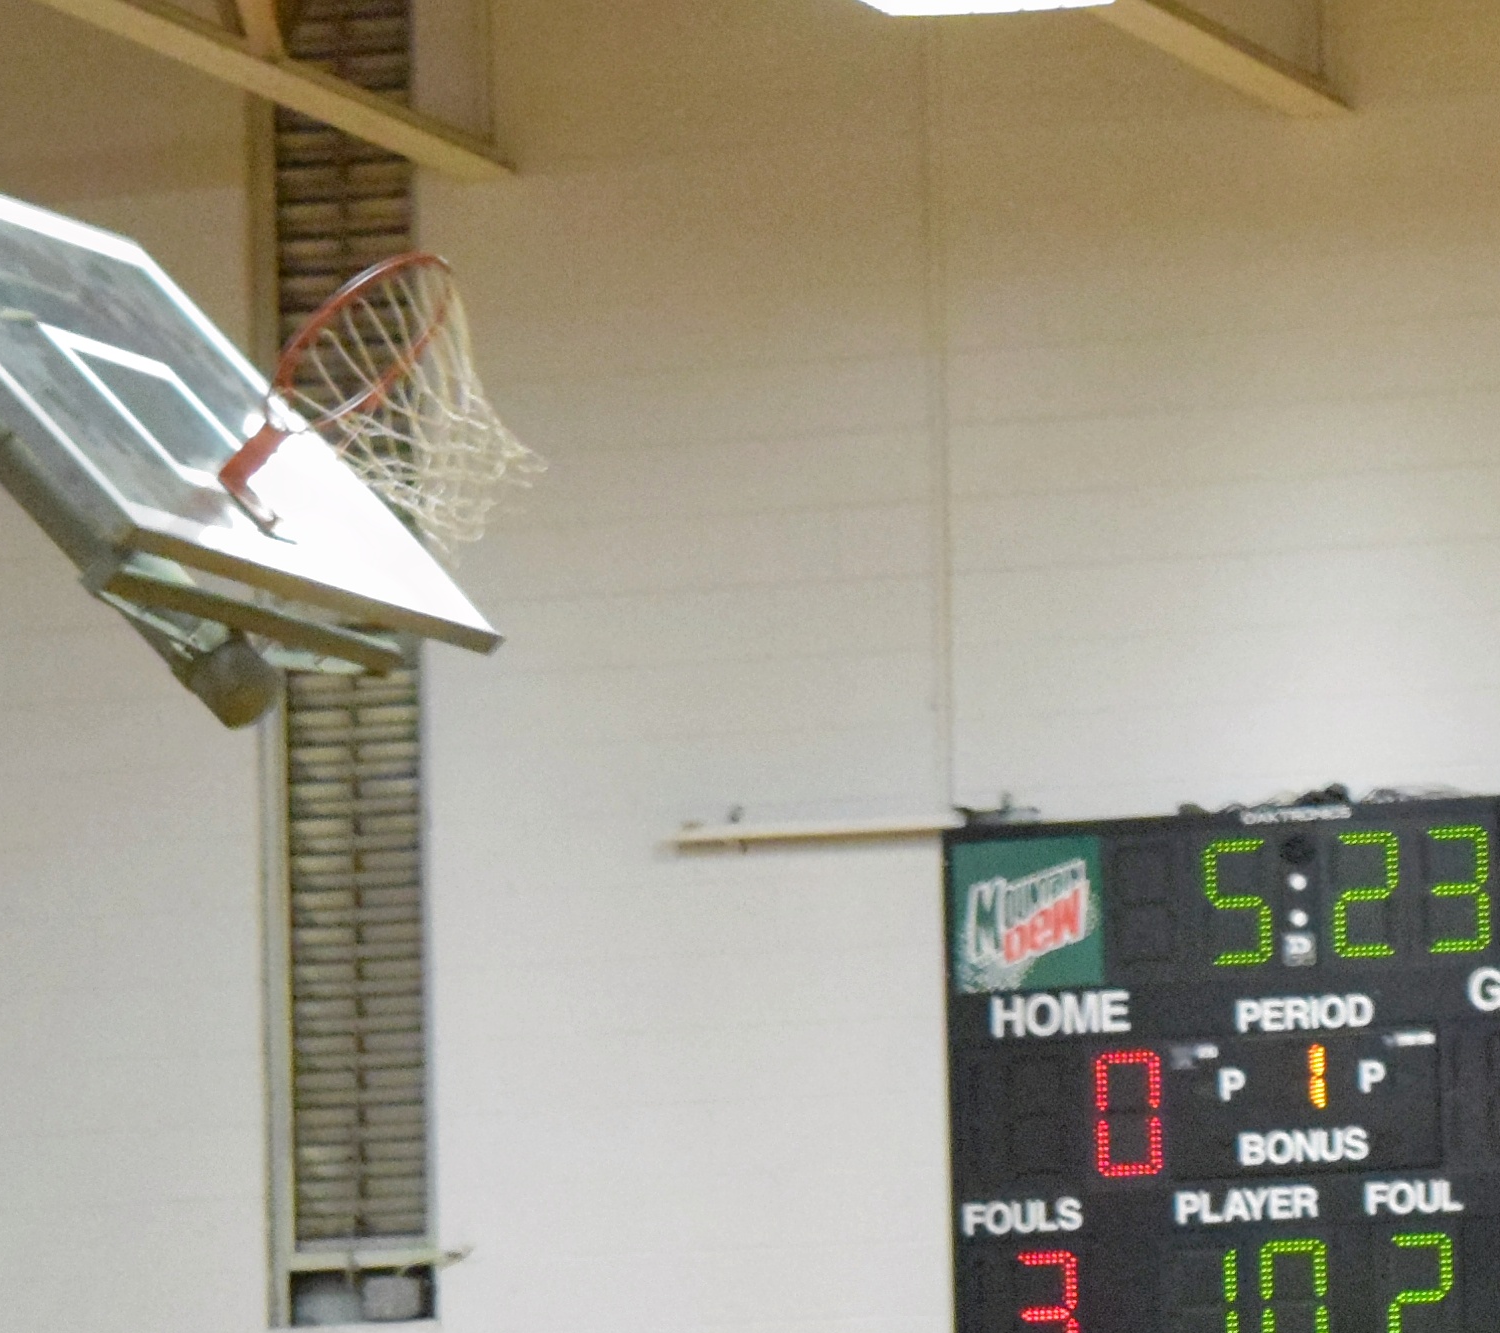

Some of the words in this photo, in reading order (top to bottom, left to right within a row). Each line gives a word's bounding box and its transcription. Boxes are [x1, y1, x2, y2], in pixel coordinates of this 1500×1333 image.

[989, 988, 1132, 1039] HOME
[1235, 994, 1375, 1033] PERIOD
[1217, 1066, 1247, 1102] P
[1307, 1042, 1328, 1109] 1
[1357, 1059, 1386, 1094] P
[1095, 1048, 1164, 1177] 0
[1237, 1126, 1370, 1166] BONUS
[962, 1197, 1085, 1237] FOULS
[1175, 1185, 1320, 1225] PLAYER
[1364, 1179, 1465, 1216] FOUL
